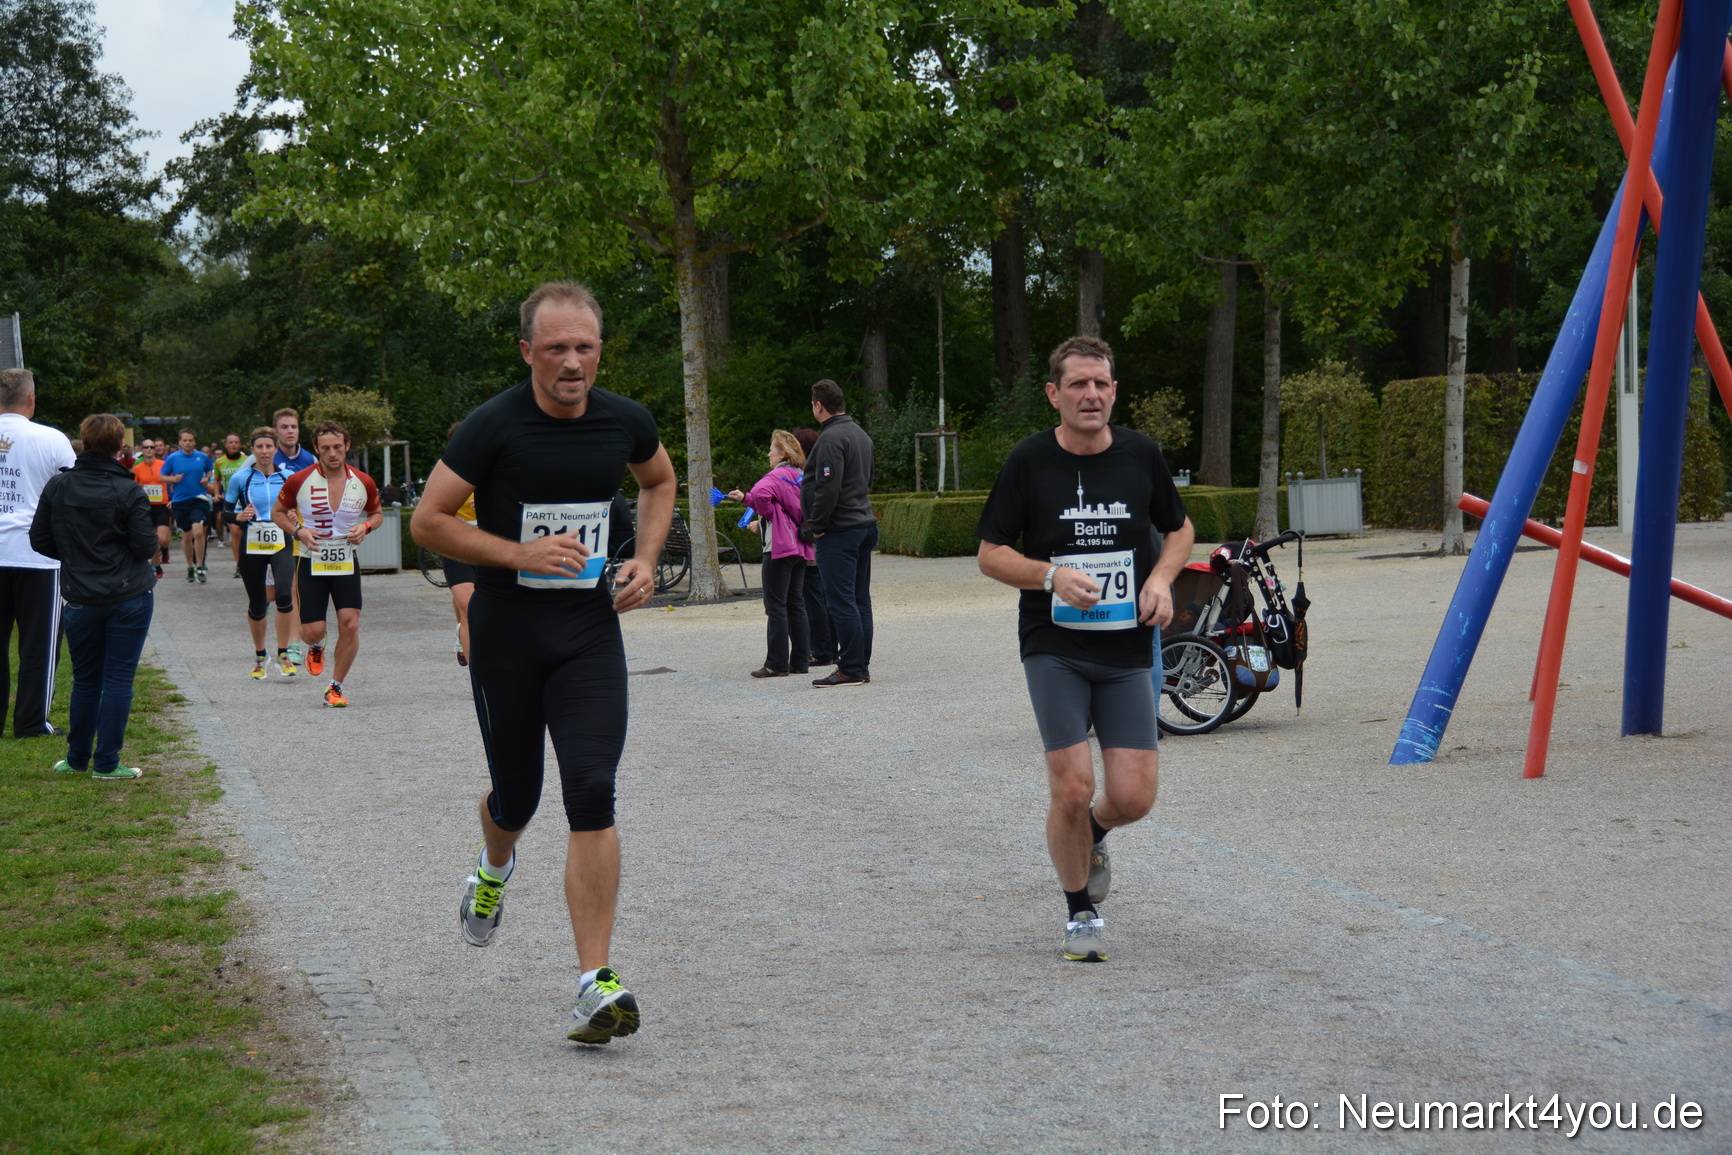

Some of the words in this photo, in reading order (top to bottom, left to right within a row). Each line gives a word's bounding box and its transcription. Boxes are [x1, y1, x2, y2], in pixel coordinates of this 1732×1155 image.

[526, 511, 558, 521] PARTL
[560, 511, 600, 521] Neumarkt
[1074, 521, 1117, 536] Berlin
[256, 529, 278, 542] 166
[1075, 538, 1100, 546] 42,195
[320, 548, 346, 562] 355
[1082, 559, 1122, 570] Neumarkt
[1081, 609, 1111, 620] Peter
